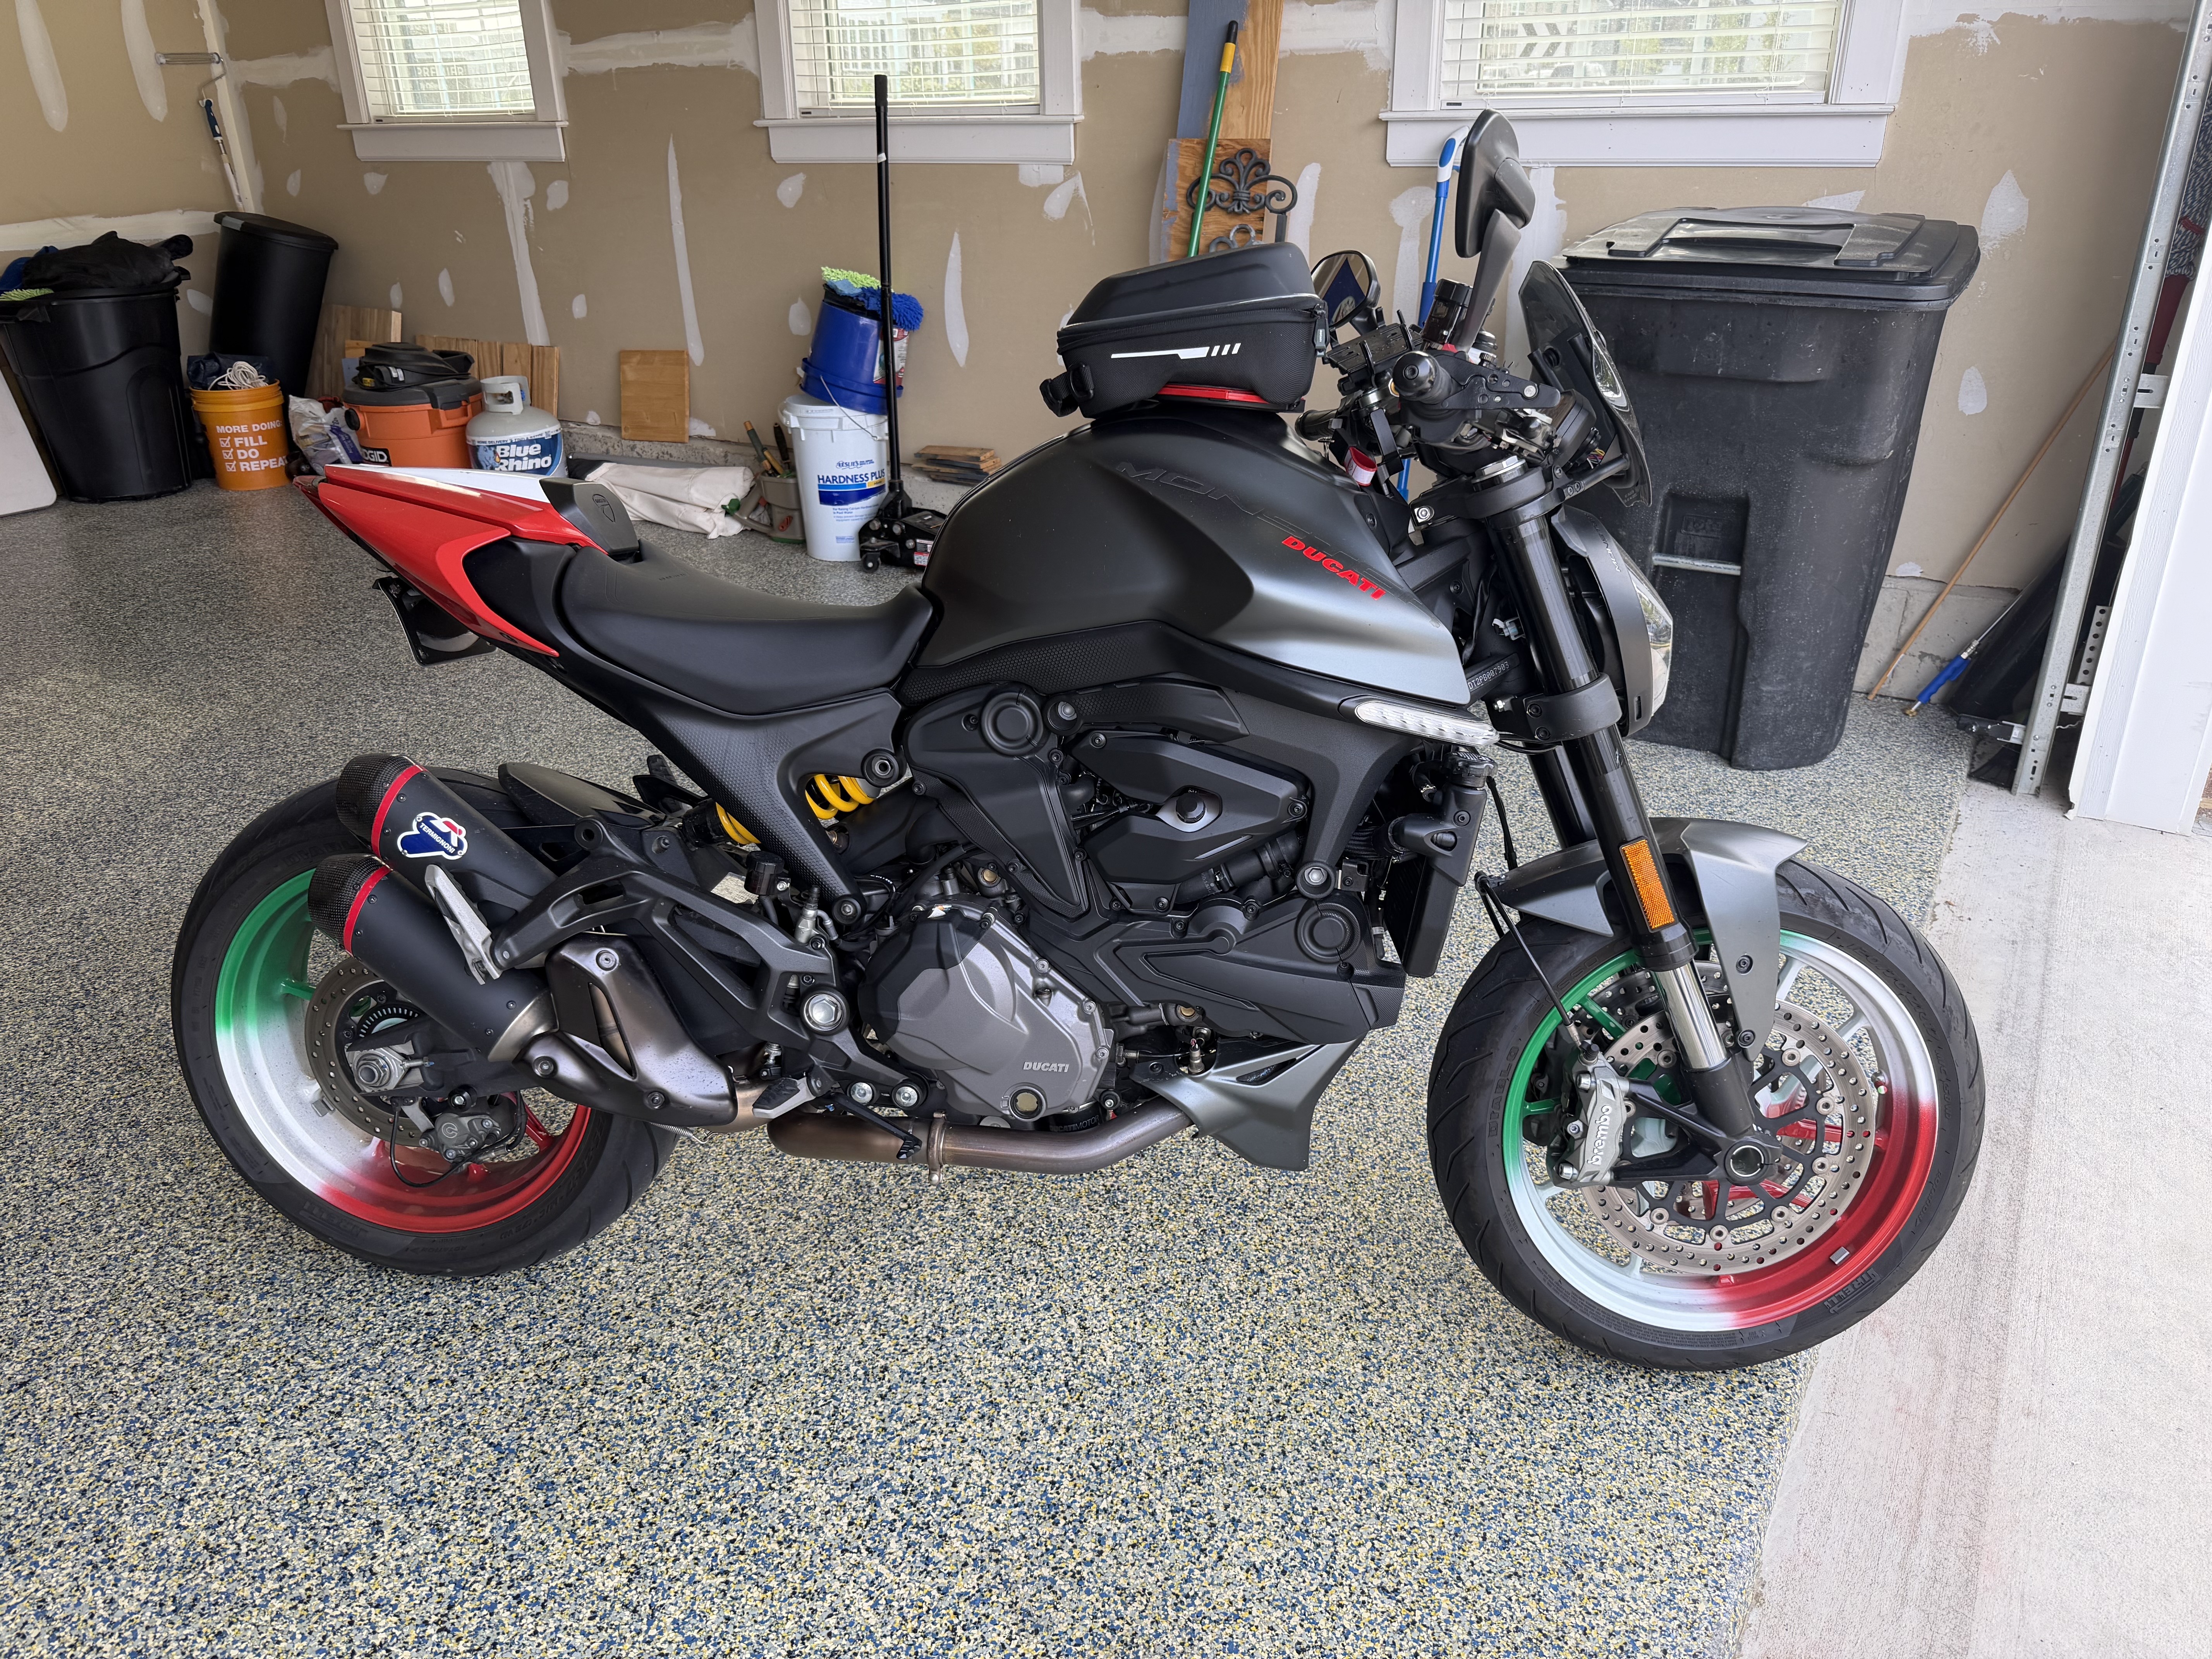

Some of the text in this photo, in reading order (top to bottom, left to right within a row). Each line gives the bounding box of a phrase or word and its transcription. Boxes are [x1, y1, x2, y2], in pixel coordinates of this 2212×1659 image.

[216, 425, 249, 433] MORE
[234, 435, 268, 447] FILL
[237, 448, 259, 459] DO
[496, 443, 541, 457] Blue
[495, 455, 551, 471] Rhino
[817, 469, 885, 484] HARDNESS PLUS
[1282, 536, 1387, 601] DUCATI
[420, 822, 455, 854] TERMIGNONI
[1023, 1061, 1069, 1072] DUCATI
[1487, 1042, 1520, 1137] DIABLO
[1587, 1104, 1613, 1165] brembo
[1822, 1266, 1883, 1315] PIRELLI
